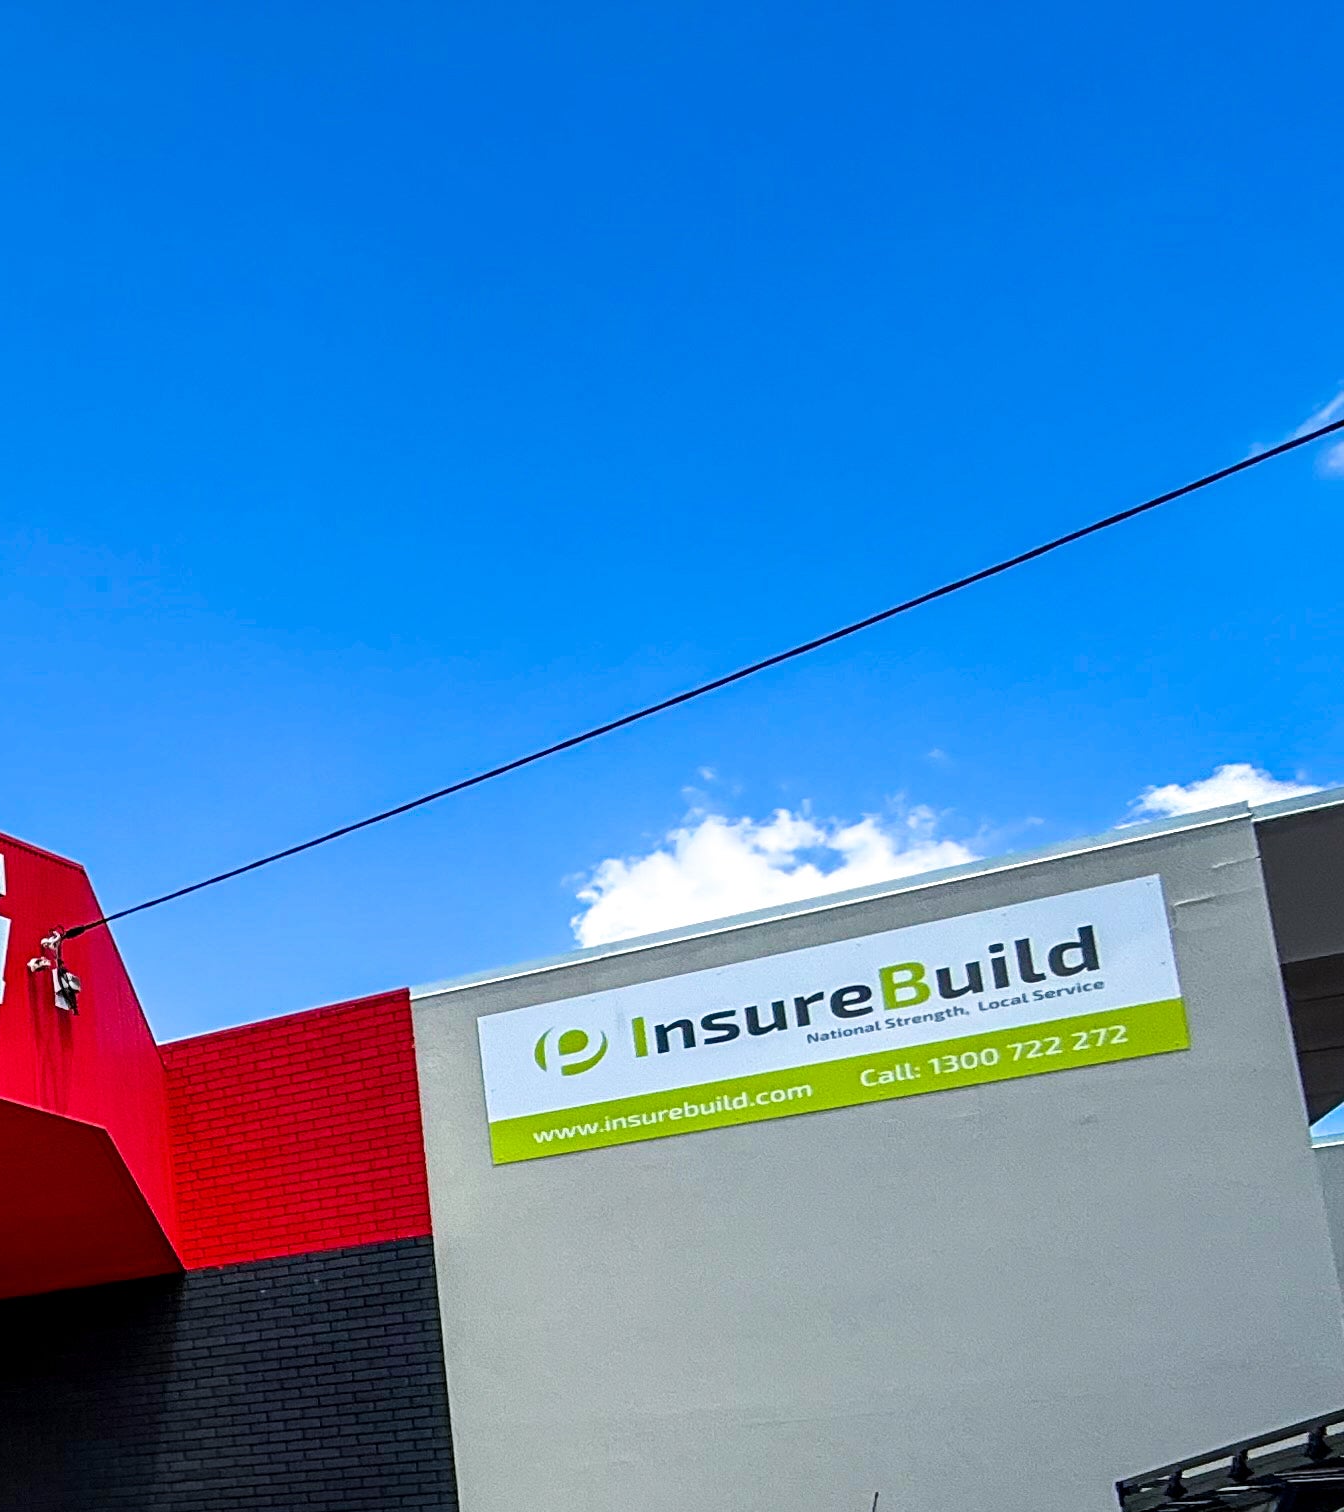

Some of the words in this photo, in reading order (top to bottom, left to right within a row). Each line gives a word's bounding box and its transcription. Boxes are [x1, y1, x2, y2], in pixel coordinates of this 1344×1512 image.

[633, 924, 1101, 1057] InsureBuild
[806, 1021, 881, 1043] National
[978, 993, 1027, 1011] Local
[1032, 980, 1104, 1001] Service
[860, 1064, 920, 1087] Call:
[929, 1048, 999, 1075] 1300
[1006, 1036, 1062, 1062] 722
[1071, 1025, 1128, 1051] 272
[533, 1084, 812, 1143] www.insurebuild.com
